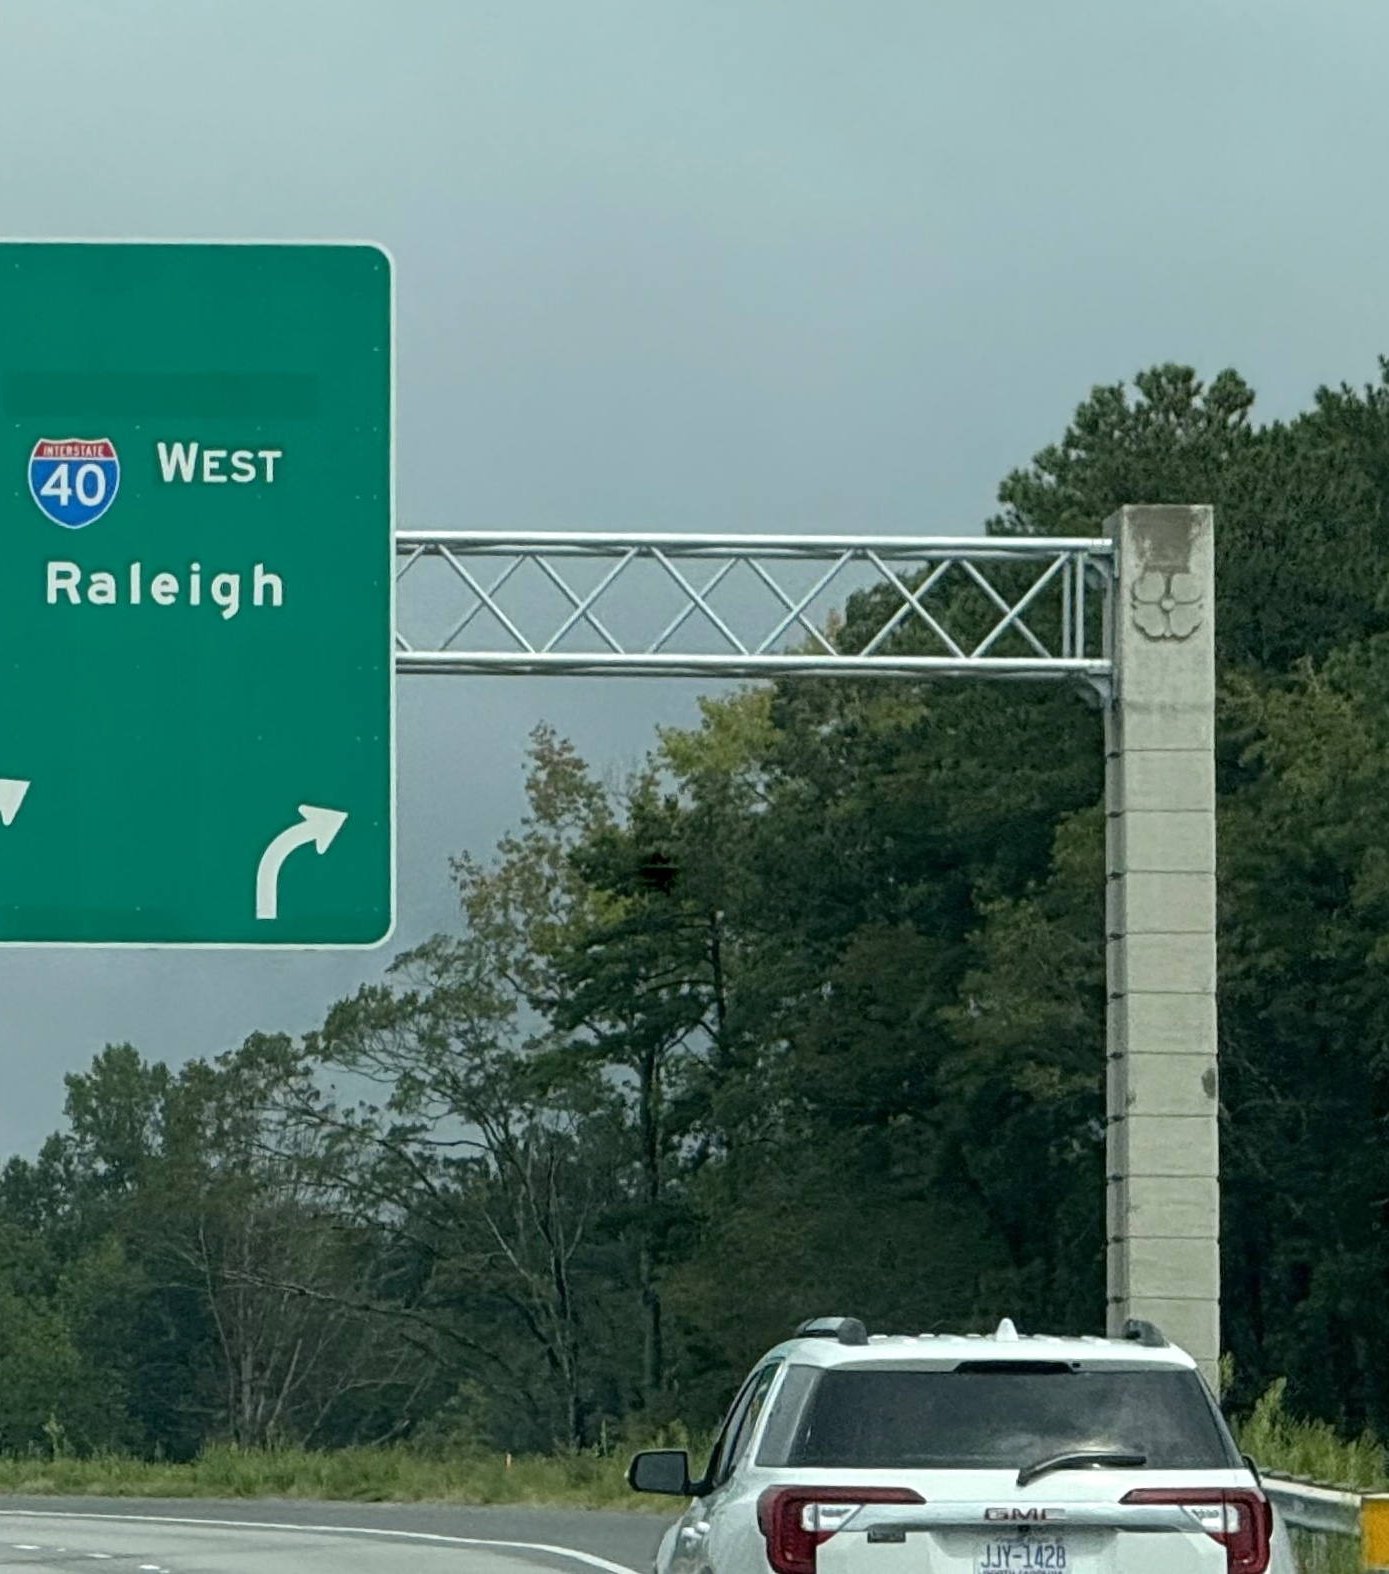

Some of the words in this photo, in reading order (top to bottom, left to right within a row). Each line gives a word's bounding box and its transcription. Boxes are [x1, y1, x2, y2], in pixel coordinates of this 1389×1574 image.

[43, 444, 105, 457] INTERSTATE
[157, 442, 282, 483] WEST
[40, 463, 106, 507] 40
[47, 561, 283, 620] Raleigh
[984, 1507, 1066, 1521] GMC
